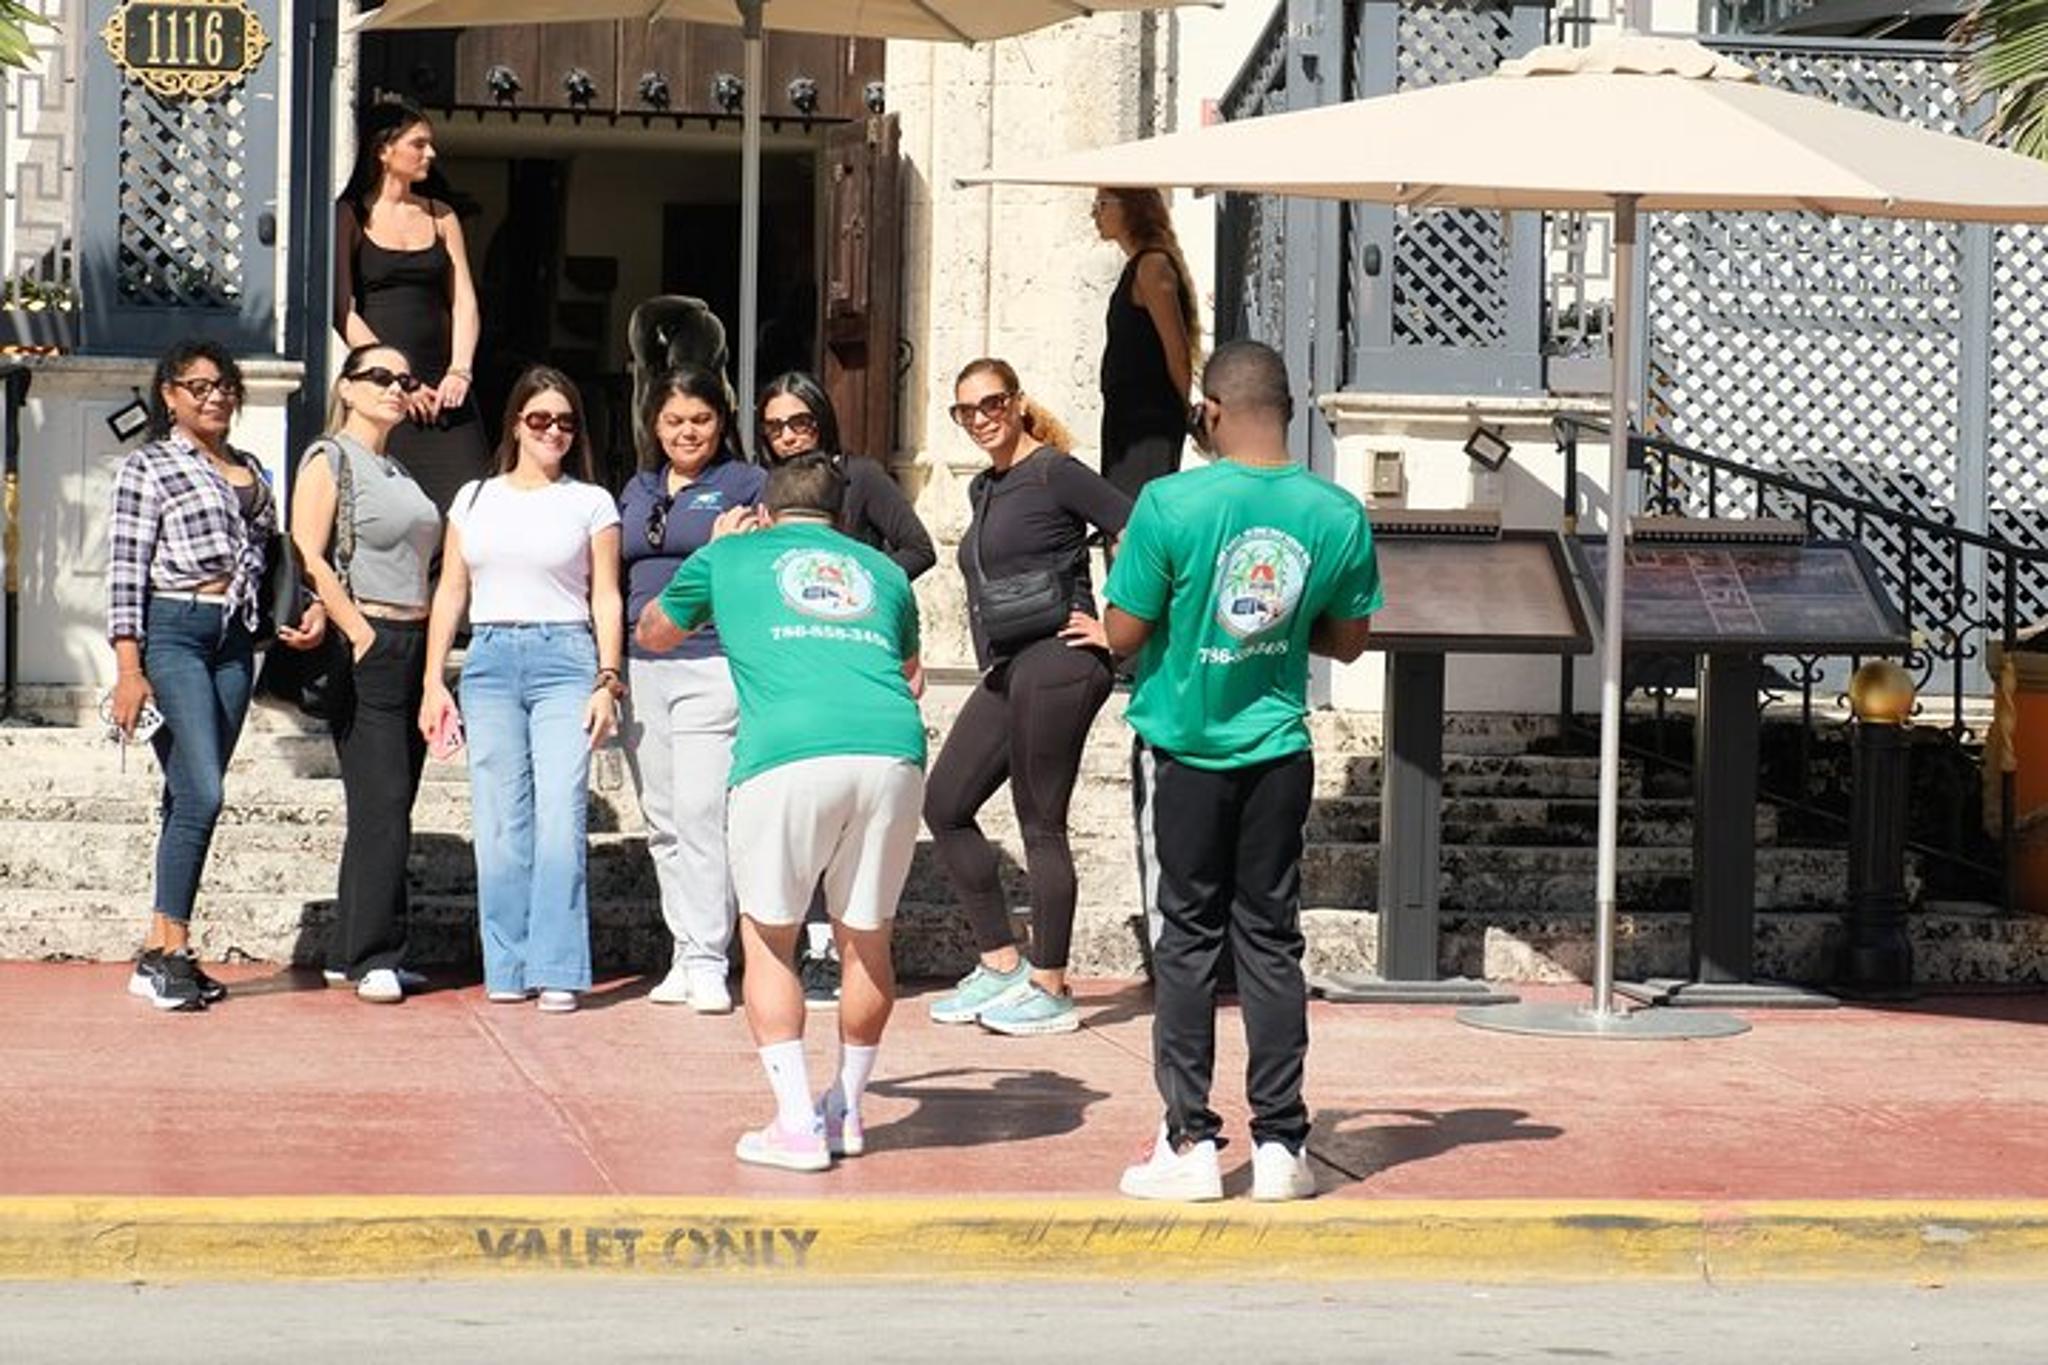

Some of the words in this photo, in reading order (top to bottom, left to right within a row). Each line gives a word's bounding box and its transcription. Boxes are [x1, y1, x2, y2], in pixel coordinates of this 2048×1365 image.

[147, 10, 223, 65] 1116
[476, 1227, 644, 1267] VALET
[662, 1227, 820, 1268] ONLY
